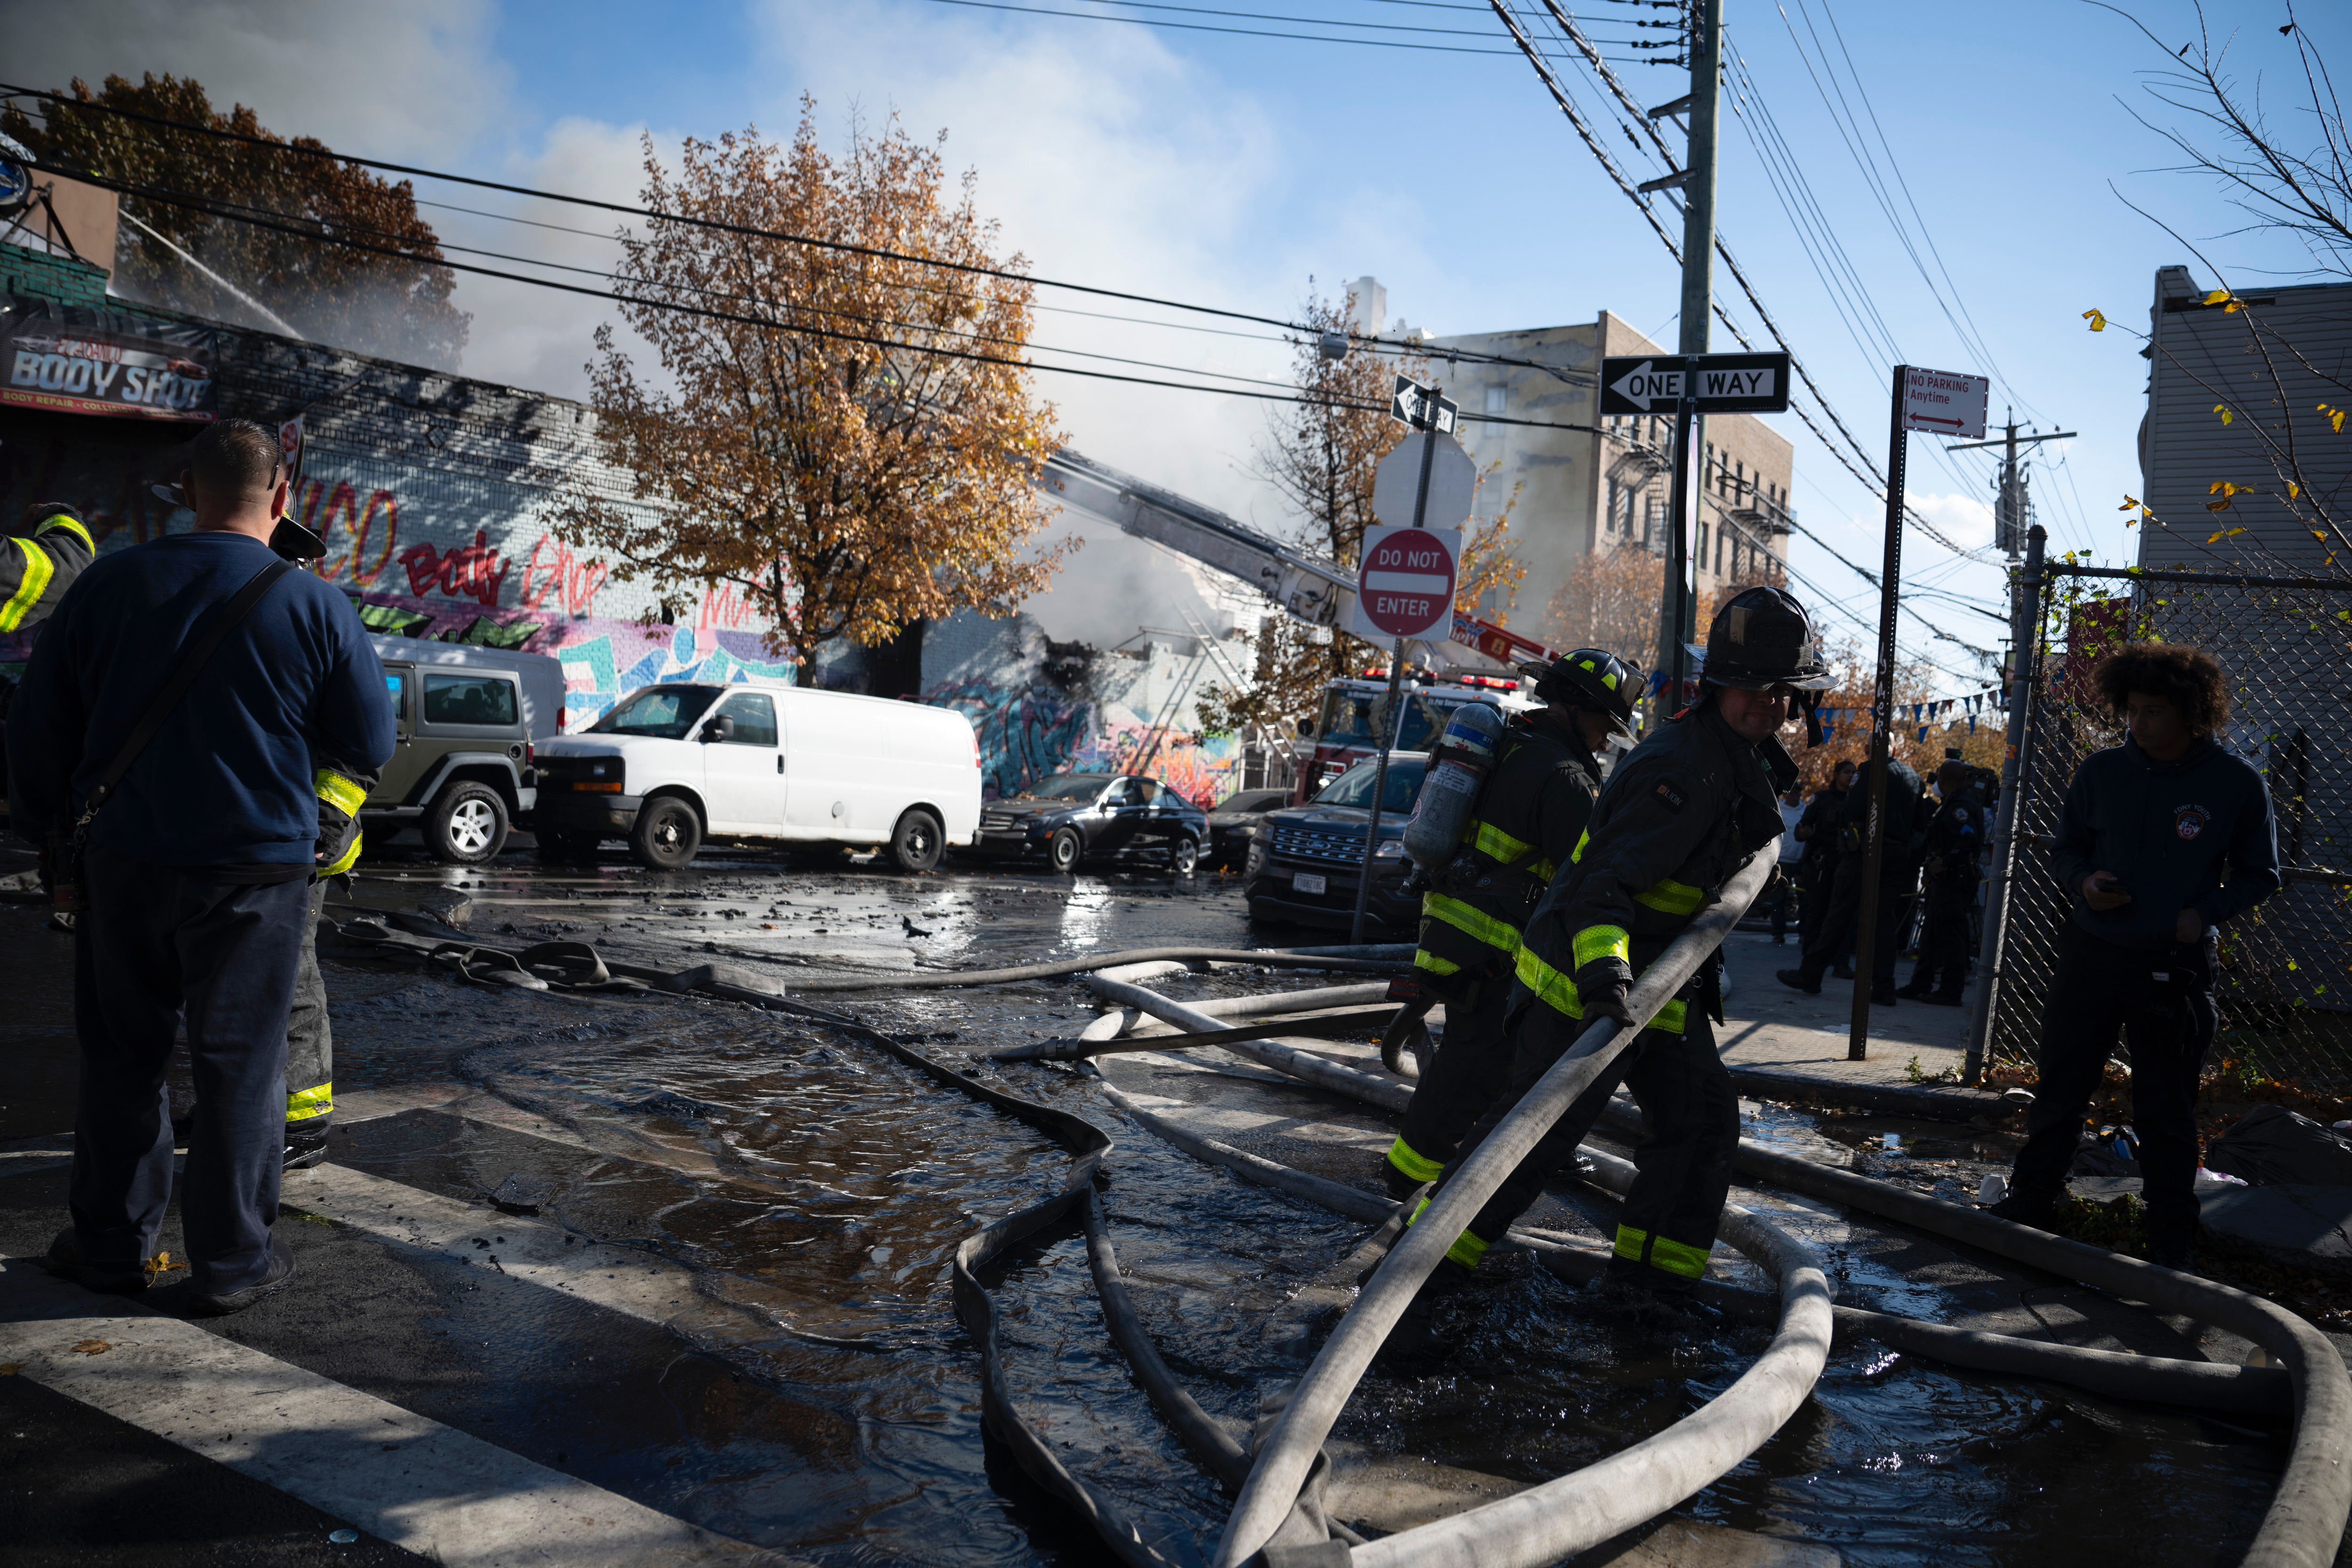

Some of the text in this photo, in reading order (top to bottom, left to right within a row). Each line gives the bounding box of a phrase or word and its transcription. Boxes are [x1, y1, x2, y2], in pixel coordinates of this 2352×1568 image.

[11, 350, 212, 409] BODY SHOP
[1629, 372, 1764, 397] ONE WAY
[1911, 374, 1970, 393] NO PARKING
[2, 391, 135, 414] BODY REPAIR COLLISION
[1910, 389, 1951, 405] Anytime
[1437, 408, 1449, 430] AY
[1379, 549, 1441, 568] DO NOT
[1376, 597, 1430, 617] ENTER
[1453, 742, 1469, 751] 3M
[1664, 789, 1682, 806] LION
[2173, 804, 2212, 820] FDNY YOUTH
